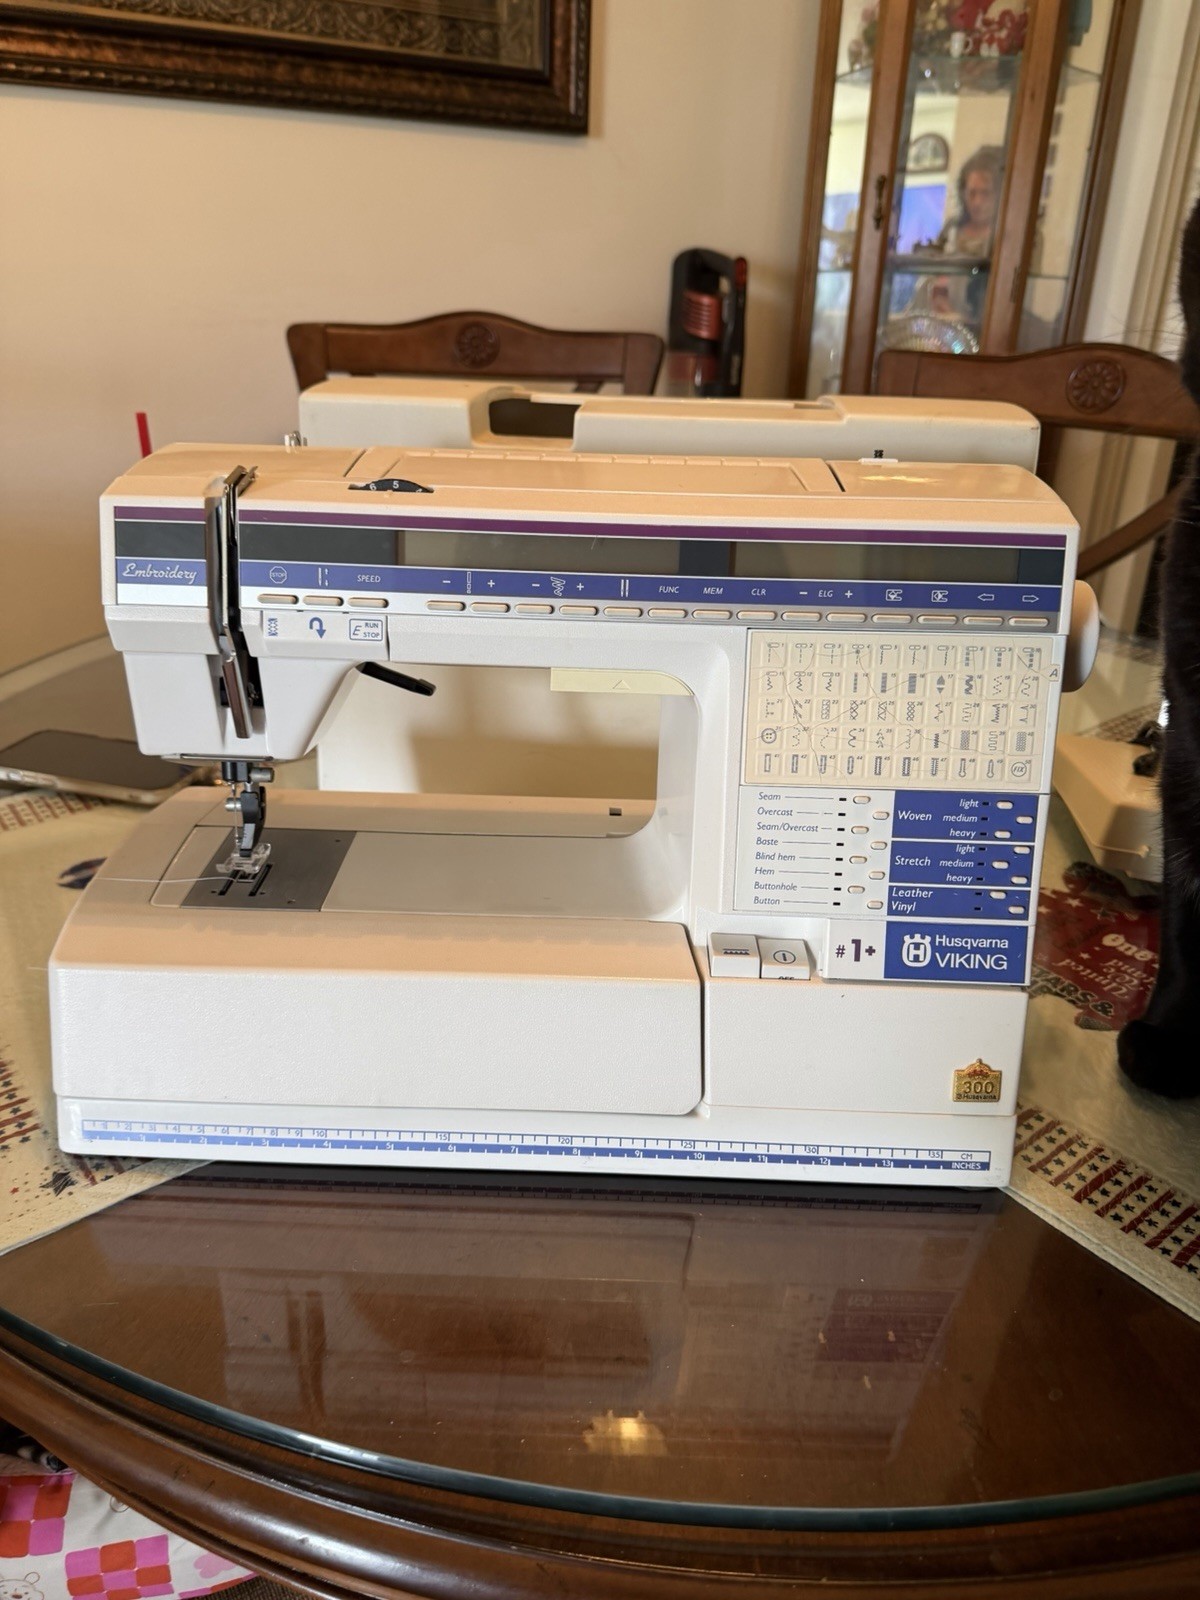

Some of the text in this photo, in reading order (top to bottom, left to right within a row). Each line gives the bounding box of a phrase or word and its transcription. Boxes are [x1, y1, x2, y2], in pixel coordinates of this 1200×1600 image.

[122, 563, 197, 584] Embroidery
[357, 574, 381, 583] SPEED
[659, 586, 679, 594] FUNC
[703, 587, 723, 595] MEM
[1050, 668, 1058, 678] A
[759, 792, 781, 800] Seam
[959, 799, 979, 809] light
[757, 807, 793, 816] Overcast
[898, 810, 932, 820] Woven
[757, 822, 818, 832] Seam/Overcast
[950, 828, 976, 839] heavy
[756, 837, 778, 846] Baste
[956, 845, 975, 855] light
[755, 852, 775, 860] Blind
[895, 855, 974, 867] Stretch medium
[946, 874, 972, 884] heavy
[754, 882, 797, 891] Buttonhole
[892, 888, 933, 898] Leather
[754, 897, 780, 905] Button
[892, 902, 916, 913] Vinyl
[936, 935, 1008, 950] Husqvarna
[1102, 933, 1152, 961] One
[936, 952, 1007, 970] VIKING
[1052, 959, 1128, 999] United
[963, 1081, 994, 1094] 300
